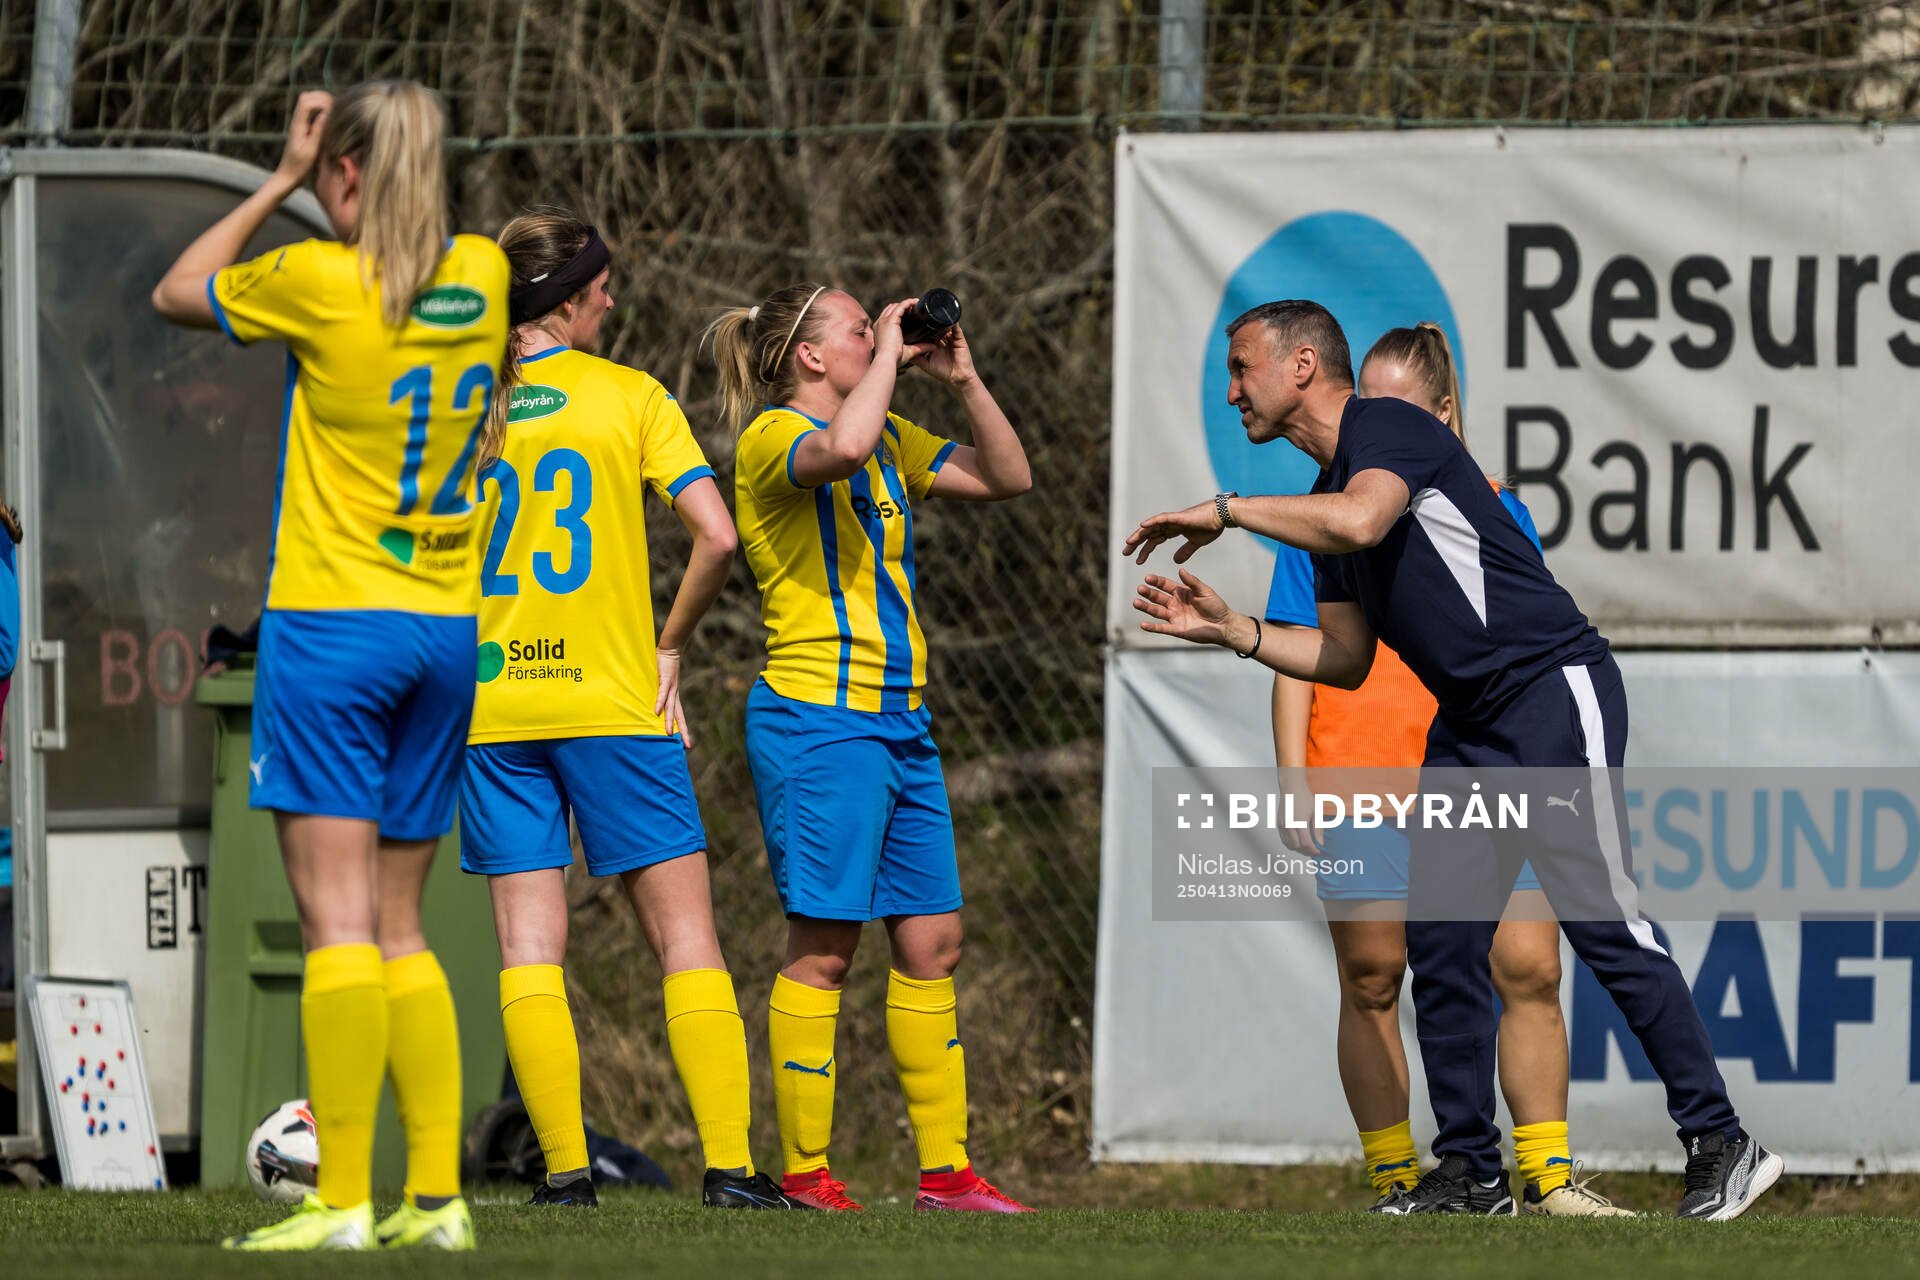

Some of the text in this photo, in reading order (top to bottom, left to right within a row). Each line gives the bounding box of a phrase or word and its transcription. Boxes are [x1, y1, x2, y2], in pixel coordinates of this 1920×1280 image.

[388, 362, 494, 516] 12
[510, 393, 555, 410] arbyrån
[1505, 404, 1822, 552] Bank
[476, 447, 593, 598] 23
[507, 664, 583, 682] Försäkring
[508, 638, 565, 662] Solid
